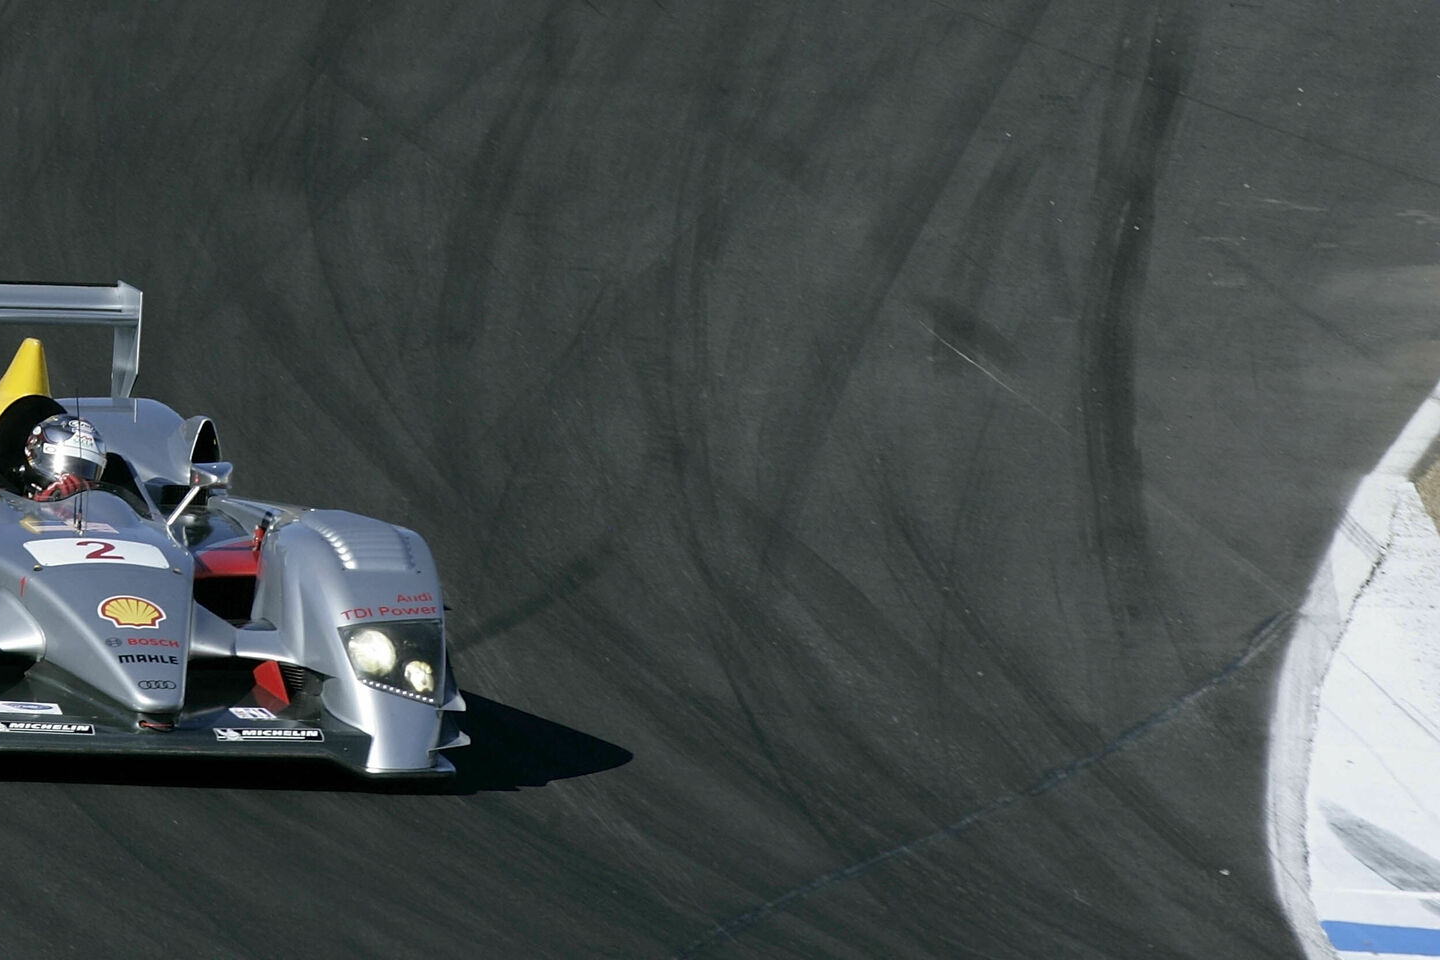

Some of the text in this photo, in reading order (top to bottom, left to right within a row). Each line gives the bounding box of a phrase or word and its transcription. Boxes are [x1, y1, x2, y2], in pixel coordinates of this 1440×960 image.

[75, 540, 125, 560] 2
[396, 591, 434, 604] Audi
[341, 605, 437, 621] TDI Power
[126, 637, 180, 648] BOSCH
[118, 653, 180, 665] MAHLE
[8, 722, 90, 732] MICHELIN
[241, 728, 319, 738] MICHELIN
